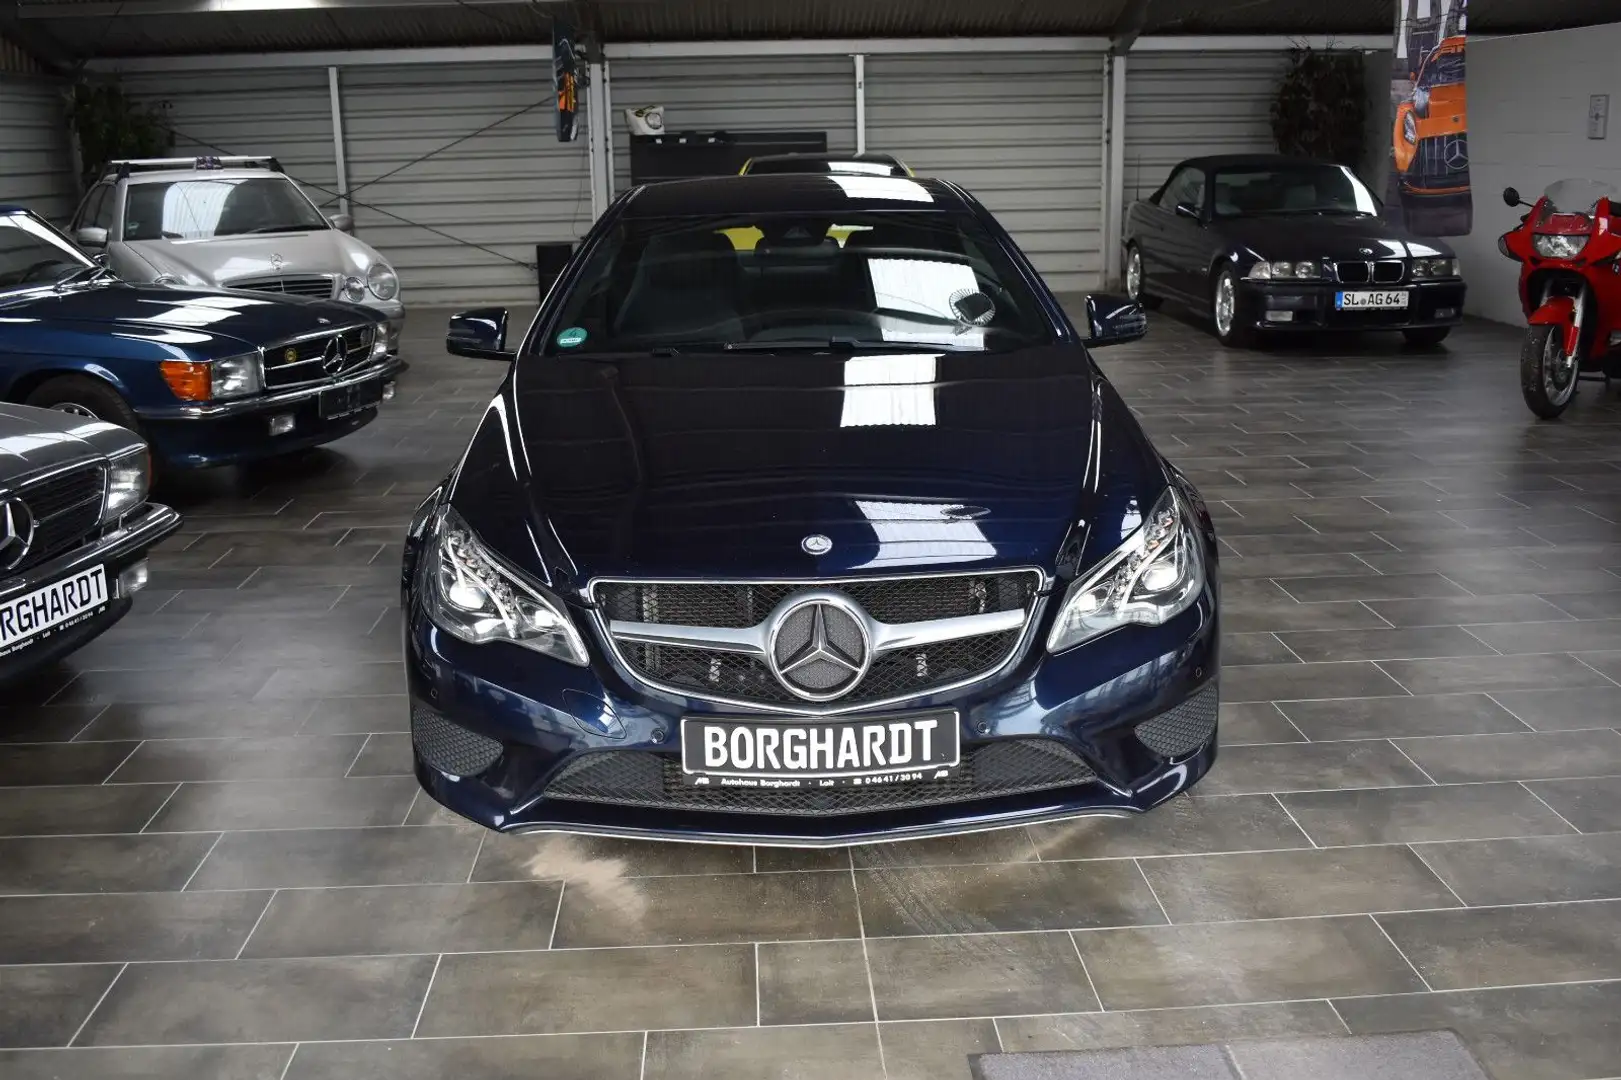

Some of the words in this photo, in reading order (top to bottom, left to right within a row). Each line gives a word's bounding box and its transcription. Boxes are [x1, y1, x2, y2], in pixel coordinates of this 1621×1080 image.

[1344, 293, 1359, 306] SL
[1367, 293, 1383, 305] AG
[1385, 293, 1400, 305] 64
[704, 719, 938, 769] BORGHARDT
